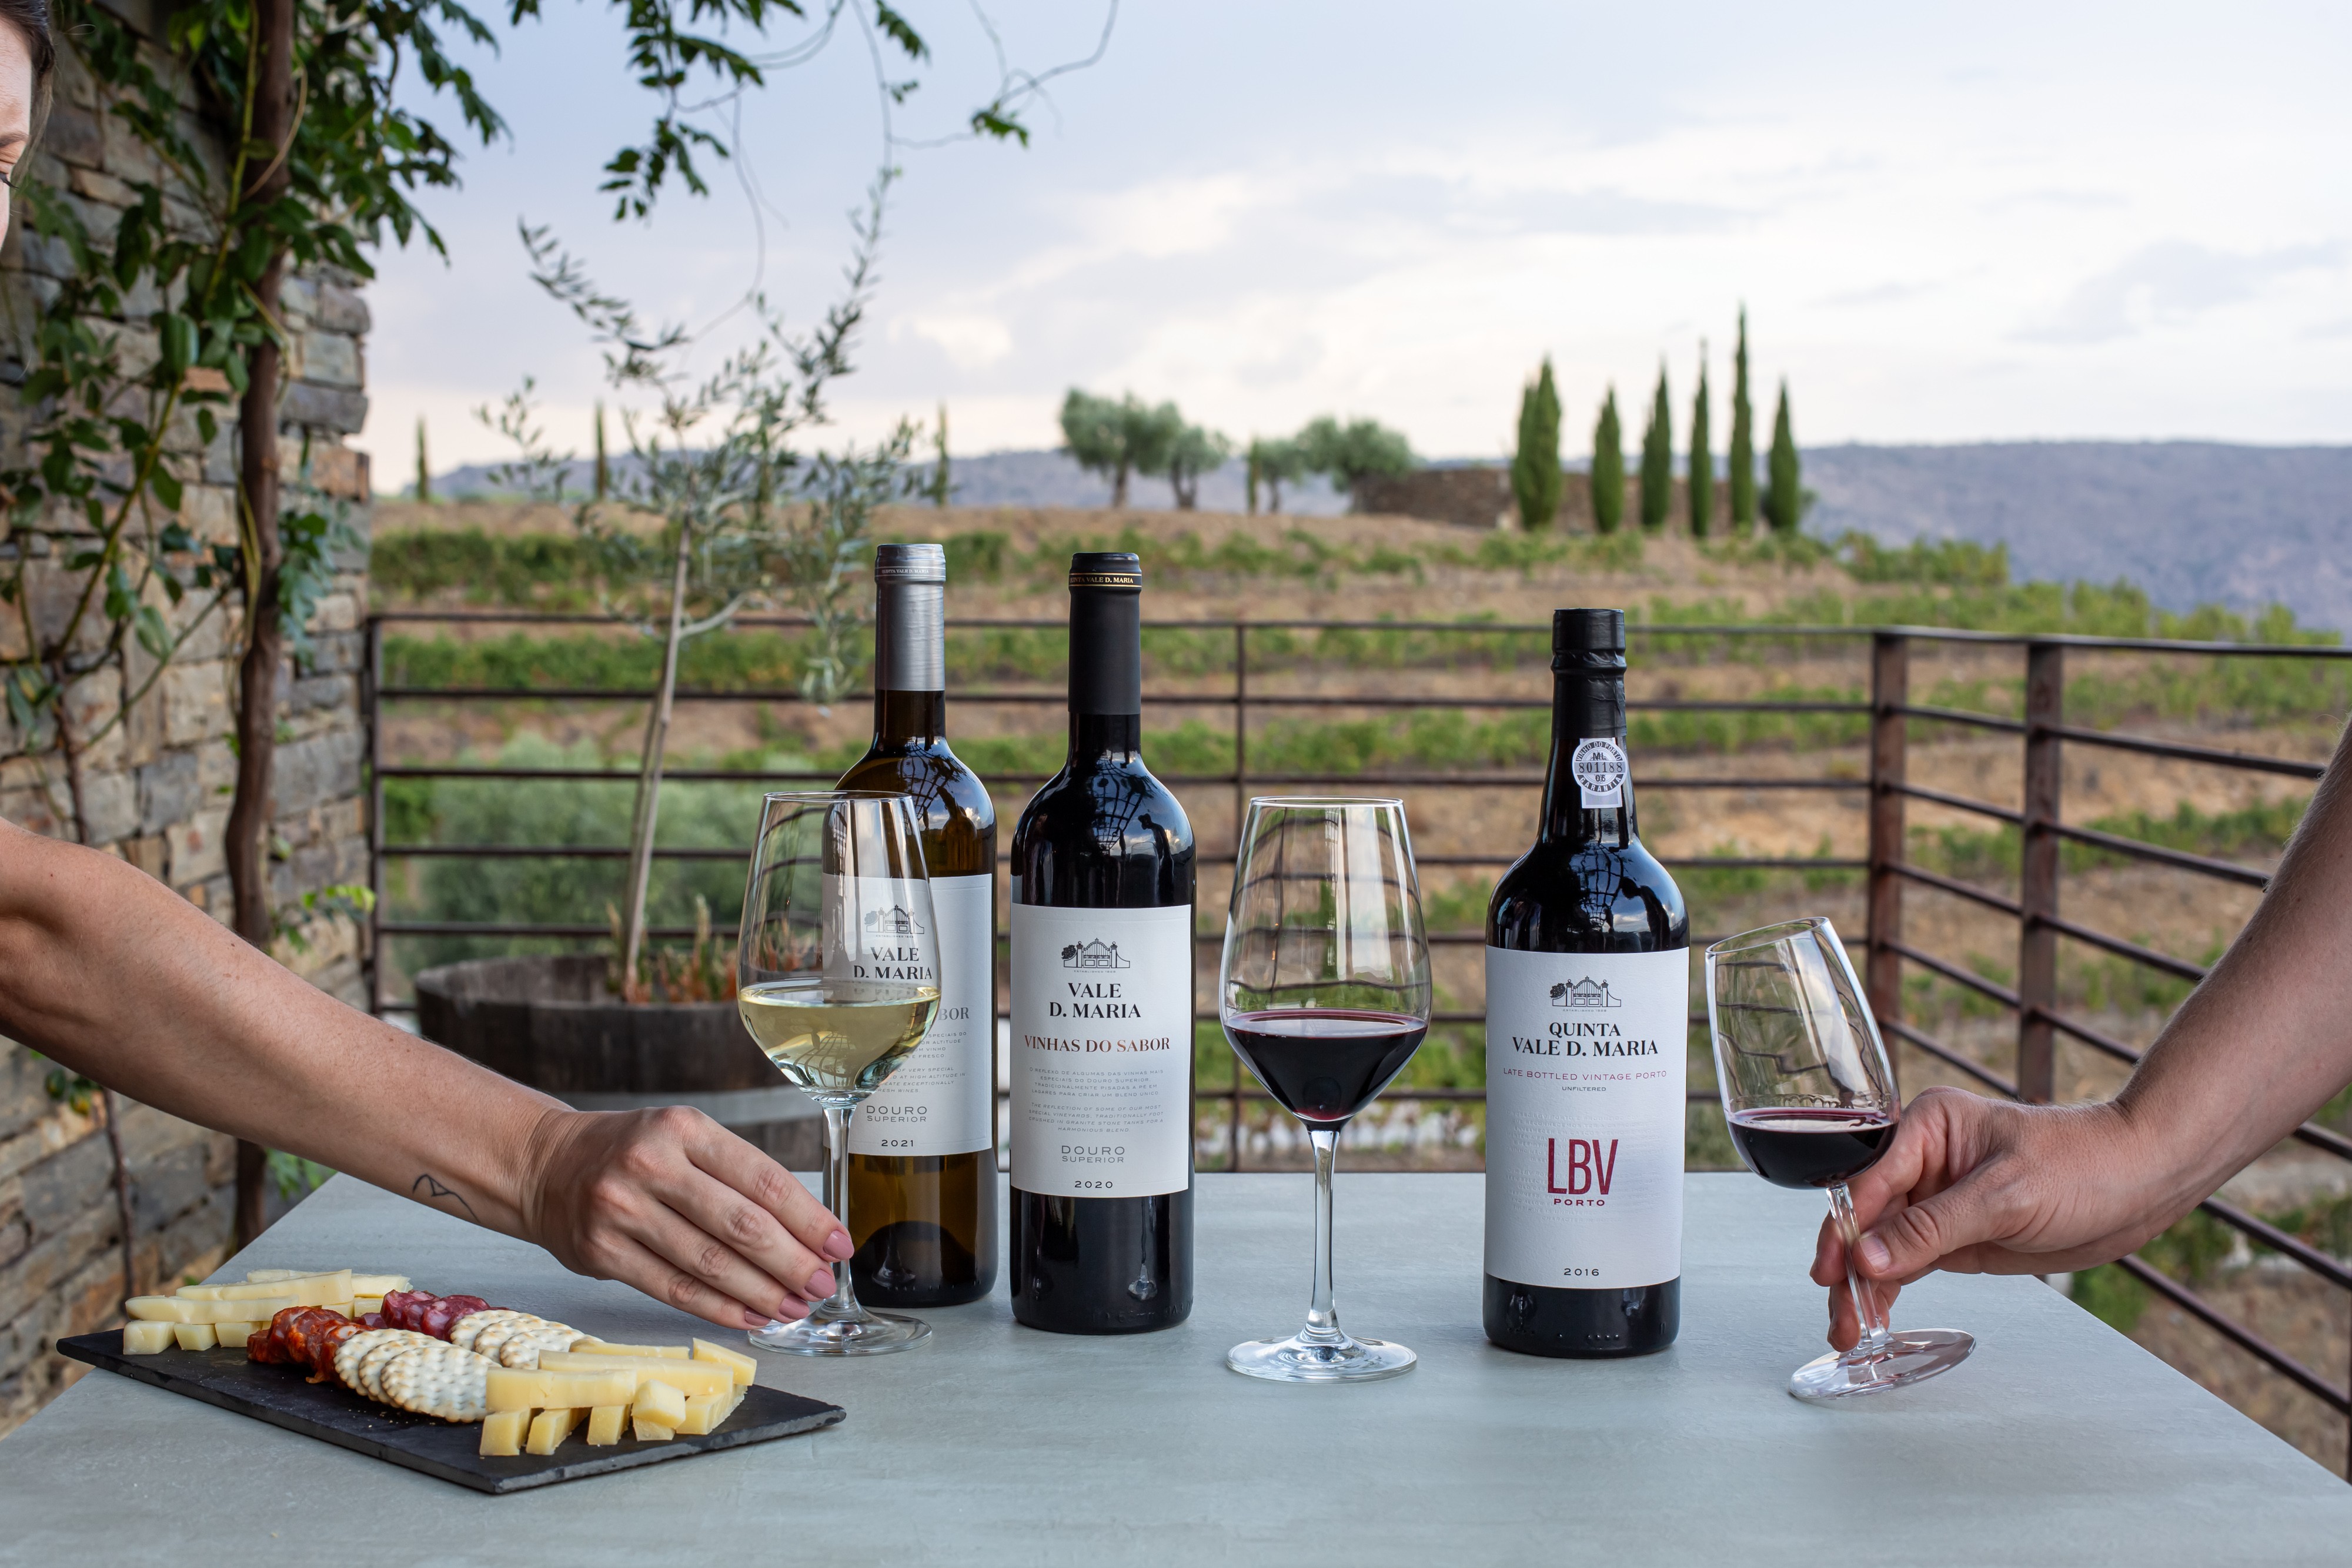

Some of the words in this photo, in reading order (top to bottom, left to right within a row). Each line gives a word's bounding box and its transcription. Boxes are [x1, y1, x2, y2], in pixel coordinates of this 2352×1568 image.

[1576, 744, 1592, 761] VINHO
[1605, 743, 1622, 761] PORTO
[1579, 762, 1622, 773] 801188
[1580, 777, 1622, 792] GARANTIA
[871, 947, 920, 961] VALE
[854, 965, 870, 978] D.
[875, 966, 933, 979] MARIA
[1068, 982, 1121, 998] VALE
[938, 1007, 970, 1021] BOR
[1050, 1002, 1067, 1018] D.
[1073, 1003, 1141, 1018] MARIA
[1549, 1022, 1621, 1038] QUINTA
[1024, 1035, 1080, 1052] VINHAS
[1086, 1039, 1112, 1052] DO
[1117, 1037, 1170, 1052] SABOR
[1512, 1037, 1560, 1055] VALE
[1566, 1041, 1586, 1057] D.
[1593, 1039, 1658, 1057] MARIA
[1504, 1068, 1523, 1076] LATE
[1527, 1071, 1578, 1080] BOTTLED
[1636, 1070, 1667, 1079] PORTO
[1034, 1082, 1097, 1091] TRADICIONALMENTE
[867, 1105, 927, 1115] DOURO
[1061, 1145, 1125, 1155] DOURO
[1548, 1138, 1619, 1195] LBV
[1553, 1198, 1605, 1206] PORTO
